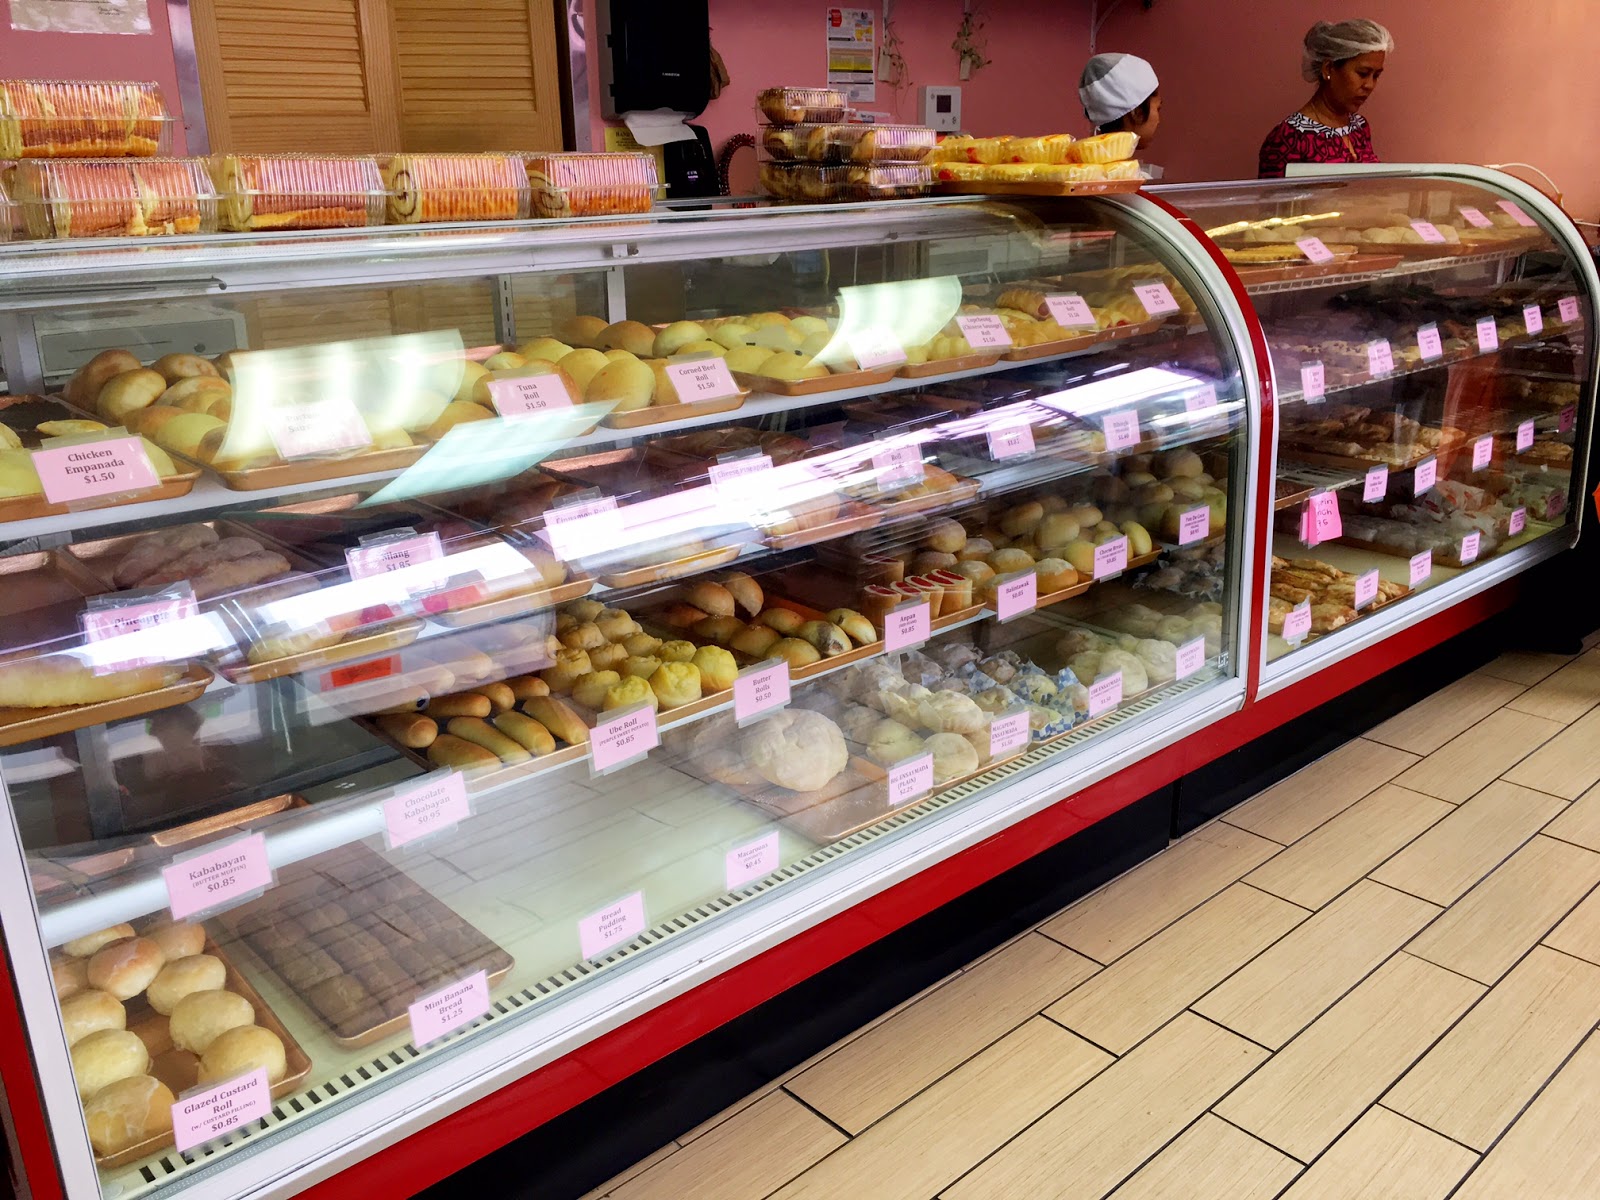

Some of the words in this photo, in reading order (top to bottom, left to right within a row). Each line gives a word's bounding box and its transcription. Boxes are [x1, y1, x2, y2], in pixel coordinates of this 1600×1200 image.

[679, 367, 702, 376] Corned
[703, 363, 717, 371] Beef
[695, 373, 710, 381] Roll
[516, 382, 538, 392] Tuna
[697, 381, 716, 391] $1.50
[523, 391, 541, 401] Roll
[525, 400, 548, 411] $1.50
[68, 449, 113, 462] Chicken
[65, 459, 125, 475] Empanada
[84, 472, 116, 484] $1.50
[386, 560, 411, 572] $1.85
[900, 613, 916, 622] Anpan
[752, 675, 771, 687] Butter
[755, 685, 770, 695] Rolls
[755, 692, 772, 703] $0.50
[609, 726, 623, 734] Ube
[623, 718, 637, 729] Roll
[616, 734, 635, 747] $0.85
[405, 787, 446, 808] Chocolate
[404, 796, 451, 820] Kababayan
[418, 810, 440, 824] $0.95
[189, 855, 247, 881] Kababayan
[192, 873, 220, 888] (BUTTER
[220, 864, 247, 878] MUFFIN)
[207, 876, 236, 893] $0.85
[601, 907, 622, 922] Bread
[598, 915, 627, 933] Pudding
[604, 925, 623, 939] $1.75
[424, 1000, 443, 1012] Mini
[444, 984, 474, 1002] Banana
[438, 998, 463, 1014] Bread
[441, 1007, 463, 1024] $1.25
[183, 1095, 218, 1115] Glazed
[219, 1078, 258, 1100] Custard
[203, 1111, 231, 1126] CUSTARD
[231, 1100, 256, 1114] FILLING)
[212, 1099, 233, 1115] Roll
[211, 1115, 238, 1133] $0.85
